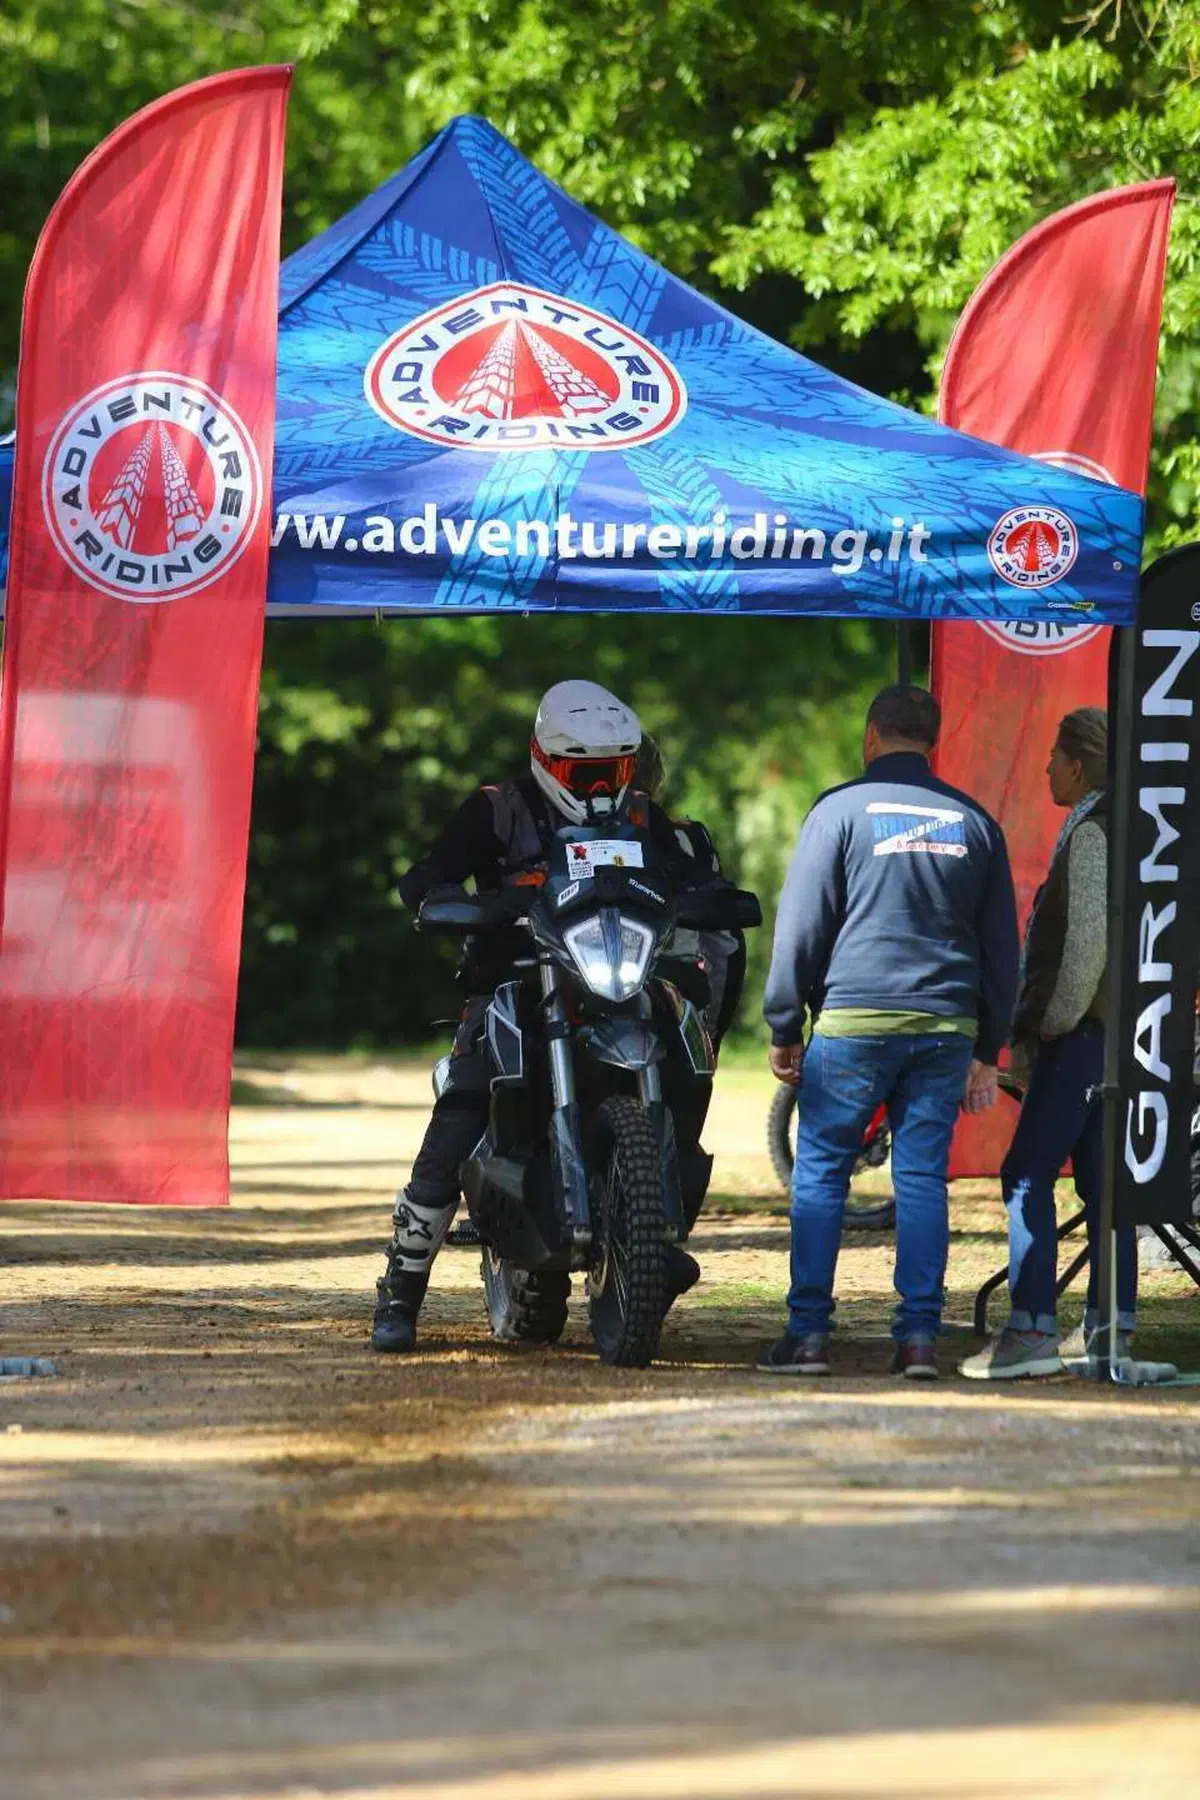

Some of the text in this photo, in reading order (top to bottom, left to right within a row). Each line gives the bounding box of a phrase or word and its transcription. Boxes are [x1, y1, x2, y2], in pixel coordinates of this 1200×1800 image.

[391, 298, 660, 404] ADVENTURE
[427, 410, 643, 441] RIDING
[61, 391, 244, 518] ADVENTURE
[74, 529, 223, 585] RIDING
[995, 510, 1071, 557] ADVENTURE
[1001, 562, 1062, 583] RIDING
[1124, 629, 1200, 1184] GARMIN
